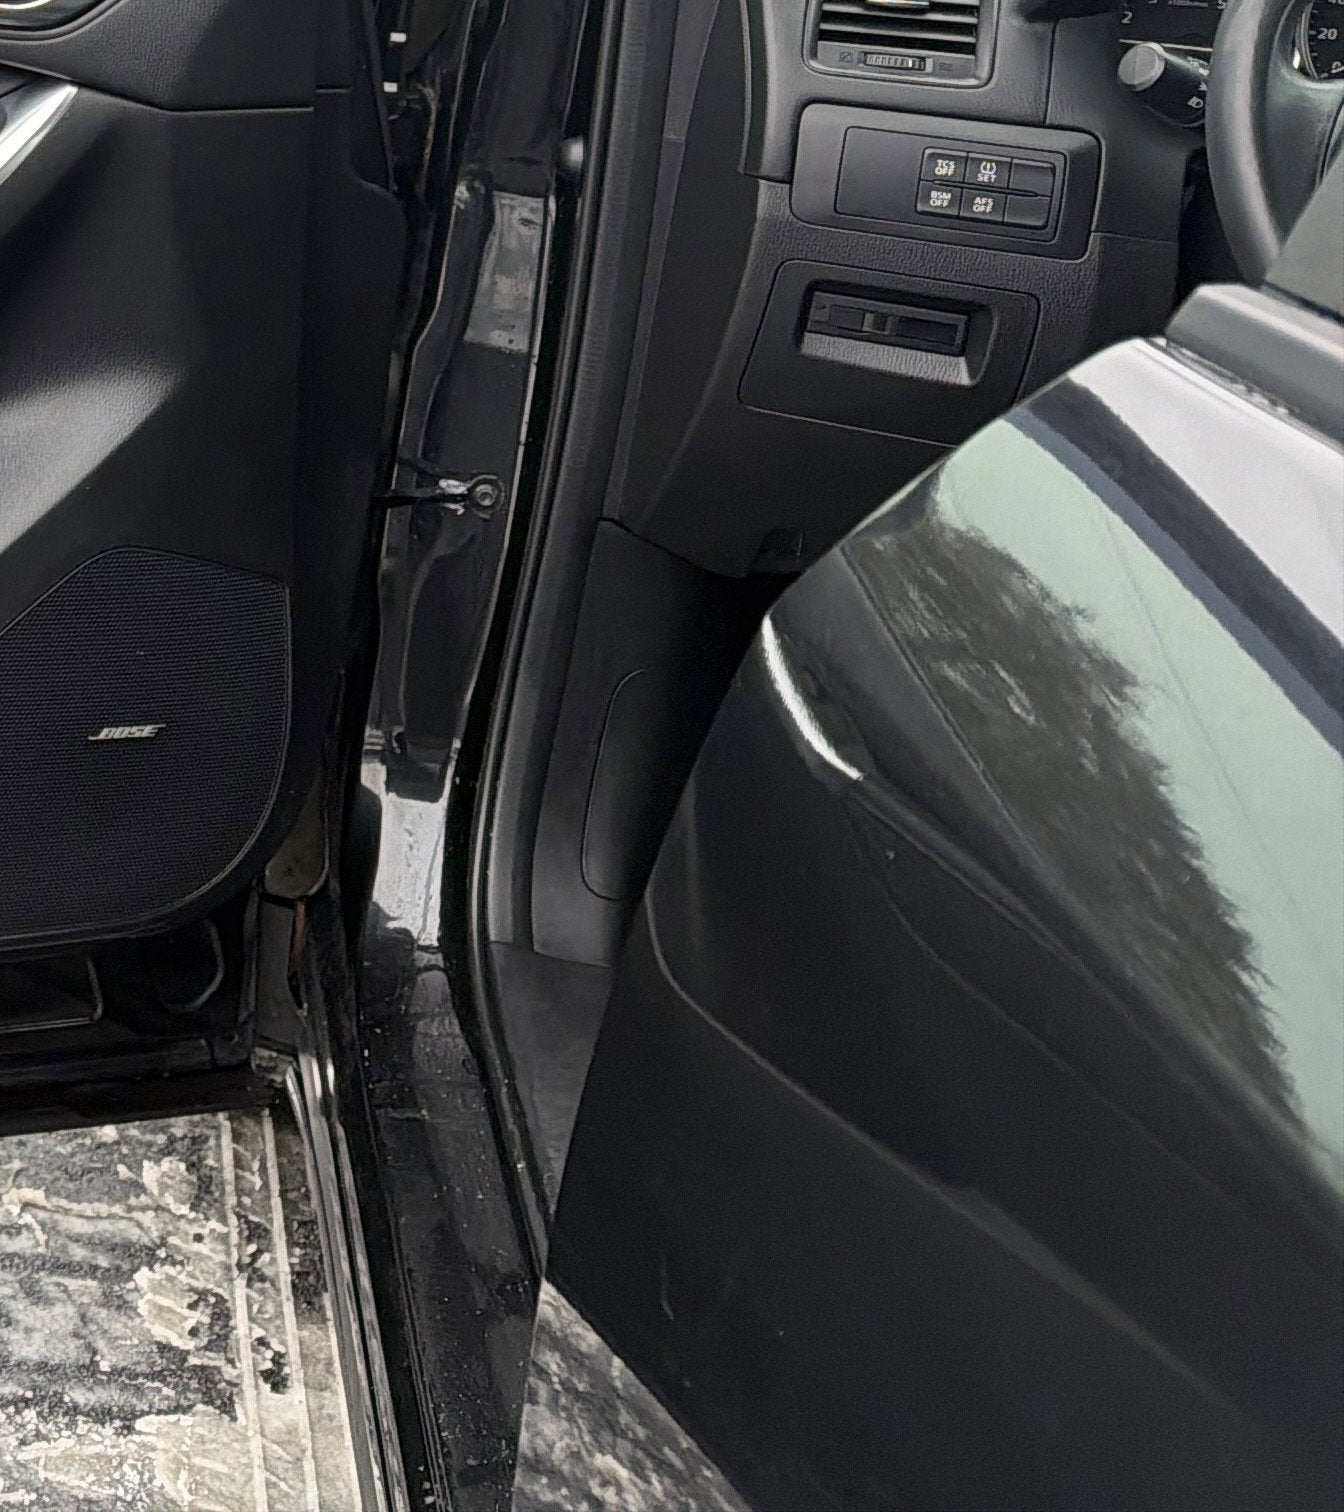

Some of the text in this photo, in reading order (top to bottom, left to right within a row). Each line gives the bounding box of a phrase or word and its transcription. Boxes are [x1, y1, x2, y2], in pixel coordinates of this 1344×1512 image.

[1121, 11, 1132, 24] 2
[1317, 28, 1338, 40] 20
[936, 159, 956, 169] TCS
[934, 167, 954, 176] OFF
[977, 173, 998, 183] SET
[930, 190, 951, 200] BSM
[929, 198, 950, 207] OFF
[973, 196, 994, 206] AFS
[972, 204, 993, 213] OFF
[87, 723, 167, 741] BOSE
